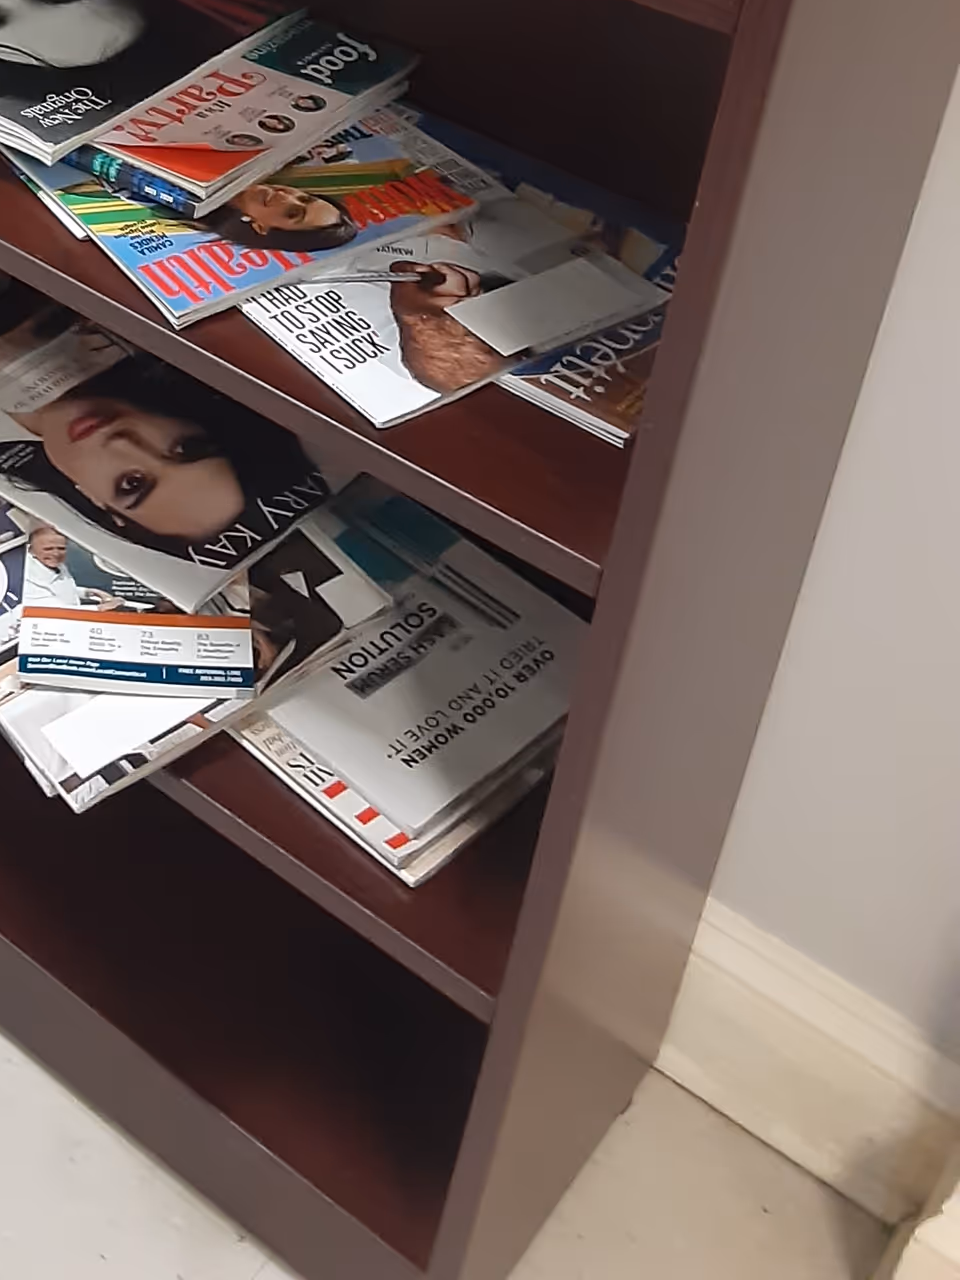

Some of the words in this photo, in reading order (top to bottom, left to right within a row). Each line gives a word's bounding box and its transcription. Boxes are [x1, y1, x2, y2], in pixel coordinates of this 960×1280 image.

[300, 32, 377, 86] food
[20, 87, 92, 119] Originals
[39, 109, 83, 128] New
[72, 96, 112, 113] The
[112, 69, 267, 144] Party!
[209, 99, 233, 116] It's
[129, 232, 169, 249] MENDES
[137, 239, 174, 256] CAMILA
[137, 240, 315, 304] Health
[261, 286, 307, 309] HAD
[269, 310, 305, 333] TO
[295, 290, 346, 323] STOP
[296, 311, 371, 353] SAYING
[256, 472, 323, 530] ARY
[187, 523, 263, 568] KAY
[330, 601, 437, 681] SOLUTION
[499, 637, 546, 671] TRIED
[483, 668, 501, 687] IT
[516, 650, 555, 685] OVER
[449, 683, 484, 711] AND
[464, 683, 516, 723] 10,000
[404, 708, 451, 739] LOVE
[400, 718, 465, 768] WOMEN
